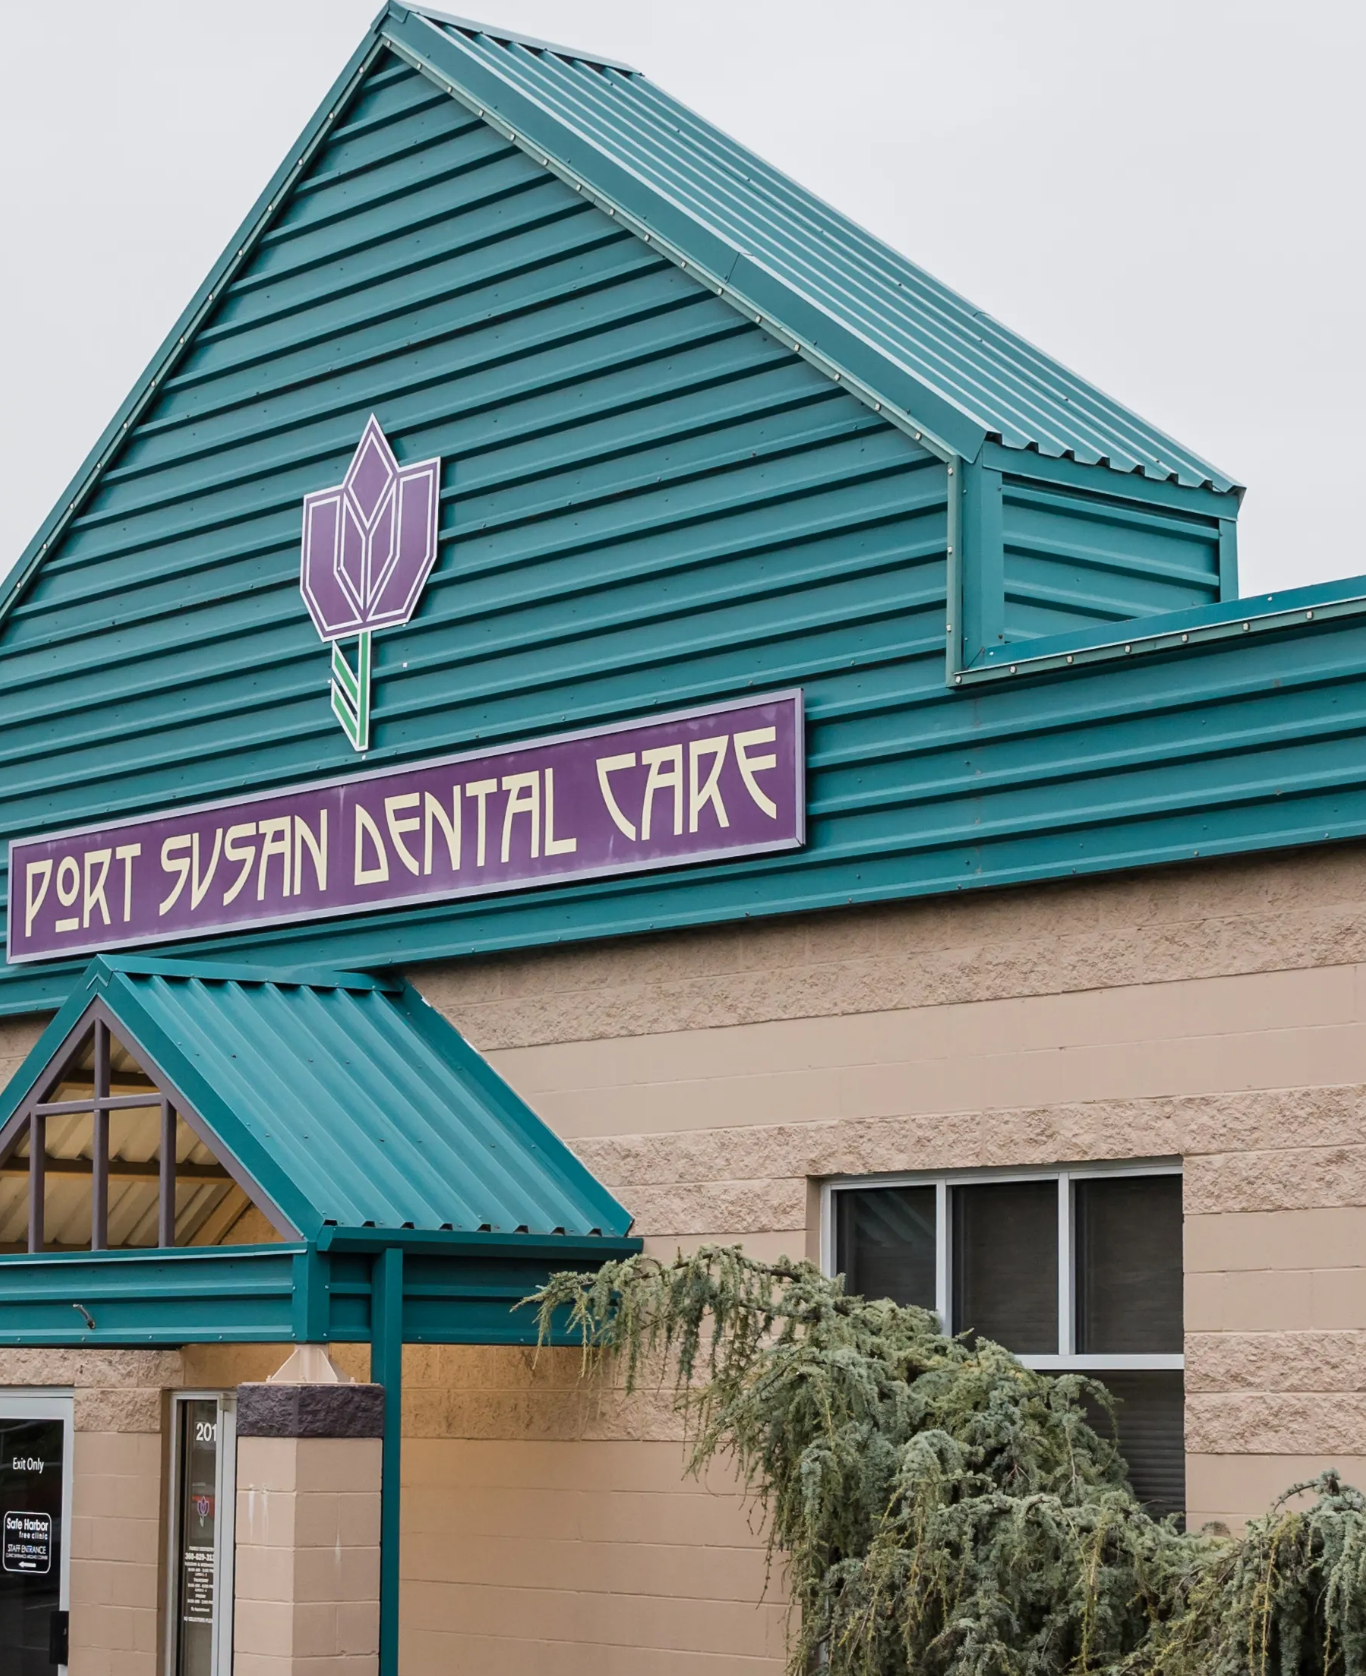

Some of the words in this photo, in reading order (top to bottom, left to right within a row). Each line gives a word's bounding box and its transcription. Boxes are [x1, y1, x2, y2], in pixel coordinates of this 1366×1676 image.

[25, 843, 141, 937] PORT
[159, 809, 328, 916] SUSAN
[354, 768, 576, 886] DENTAL
[596, 726, 777, 841] CARE
[12, 1457, 26, 1471] Exit
[26, 1457, 45, 1474] Only
[6, 1517, 23, 1530] Safe
[23, 1518, 49, 1531] Harbor
[7, 1543, 21, 1553] STAFF
